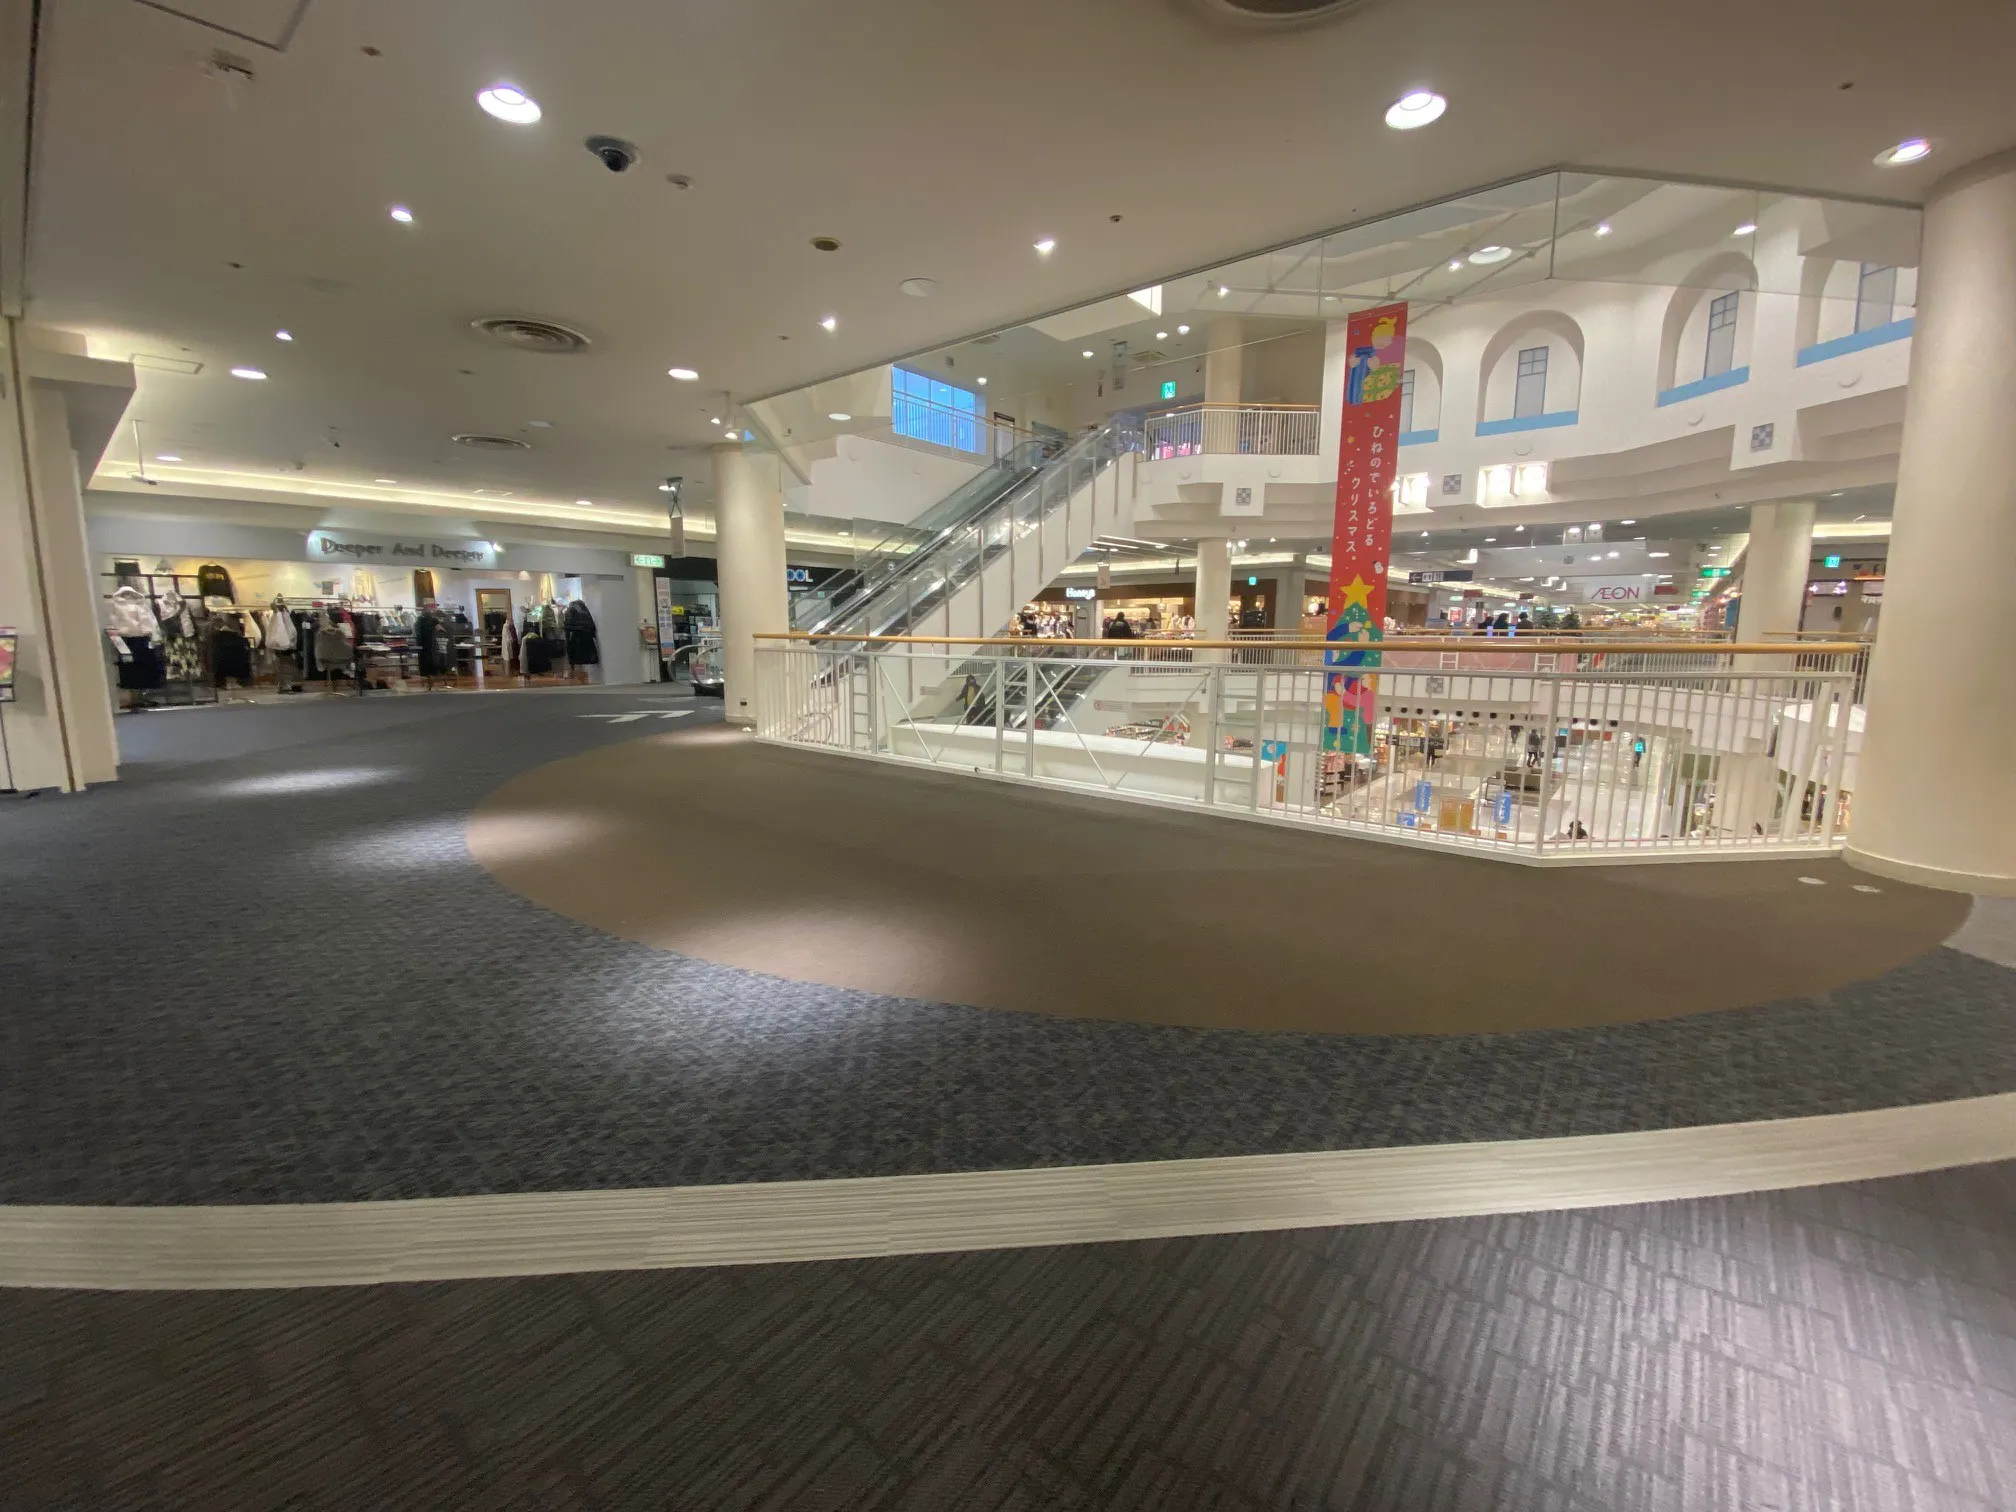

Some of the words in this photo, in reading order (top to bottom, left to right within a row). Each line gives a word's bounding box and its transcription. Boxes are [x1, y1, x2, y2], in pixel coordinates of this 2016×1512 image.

[1364, 425, 1385, 547] ひねのでいろどる
[392, 542, 425, 558] And
